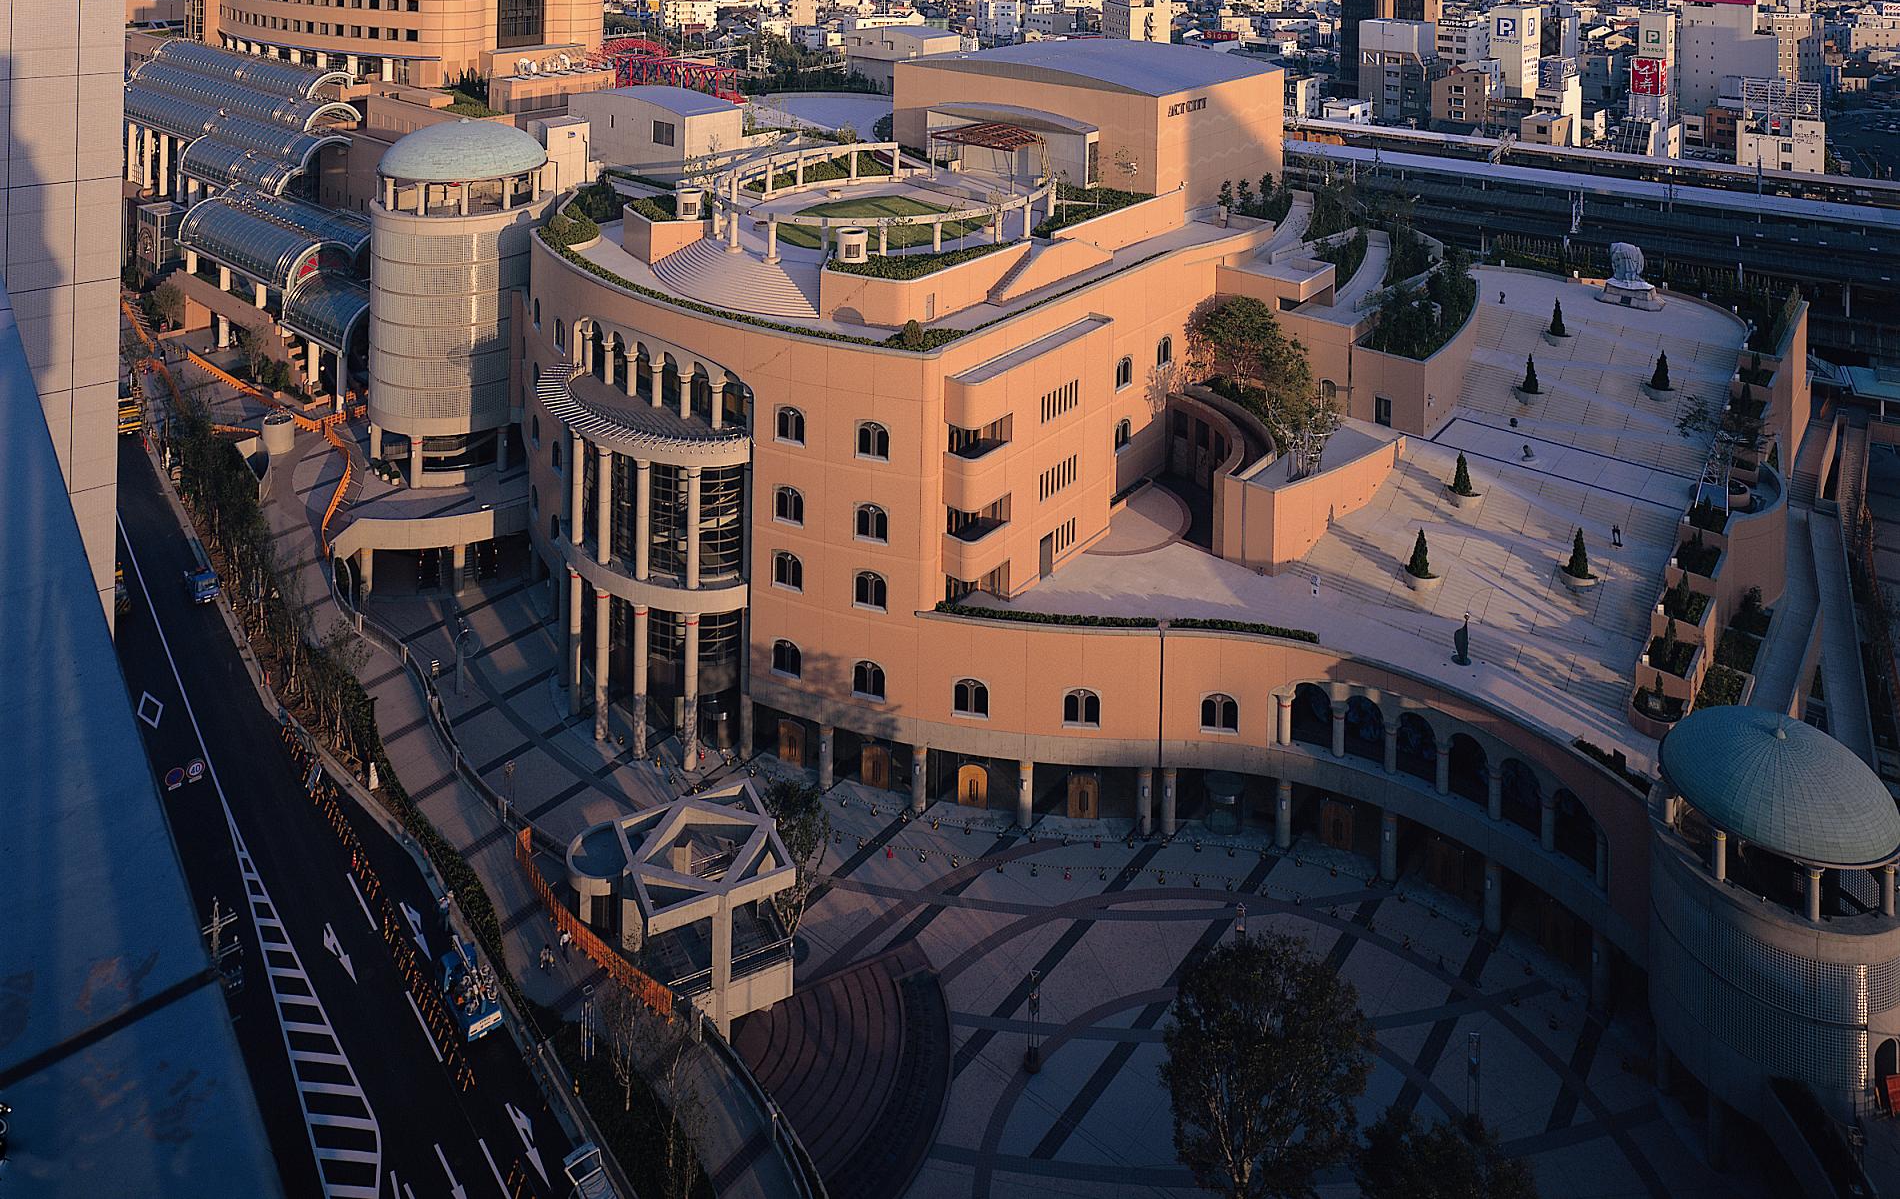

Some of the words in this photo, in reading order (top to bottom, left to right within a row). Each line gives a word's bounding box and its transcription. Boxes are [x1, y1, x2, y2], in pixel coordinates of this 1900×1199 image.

[1168, 103, 1185, 117] ACT
[1186, 97, 1207, 112] CITY
[190, 764, 201, 774] 40
